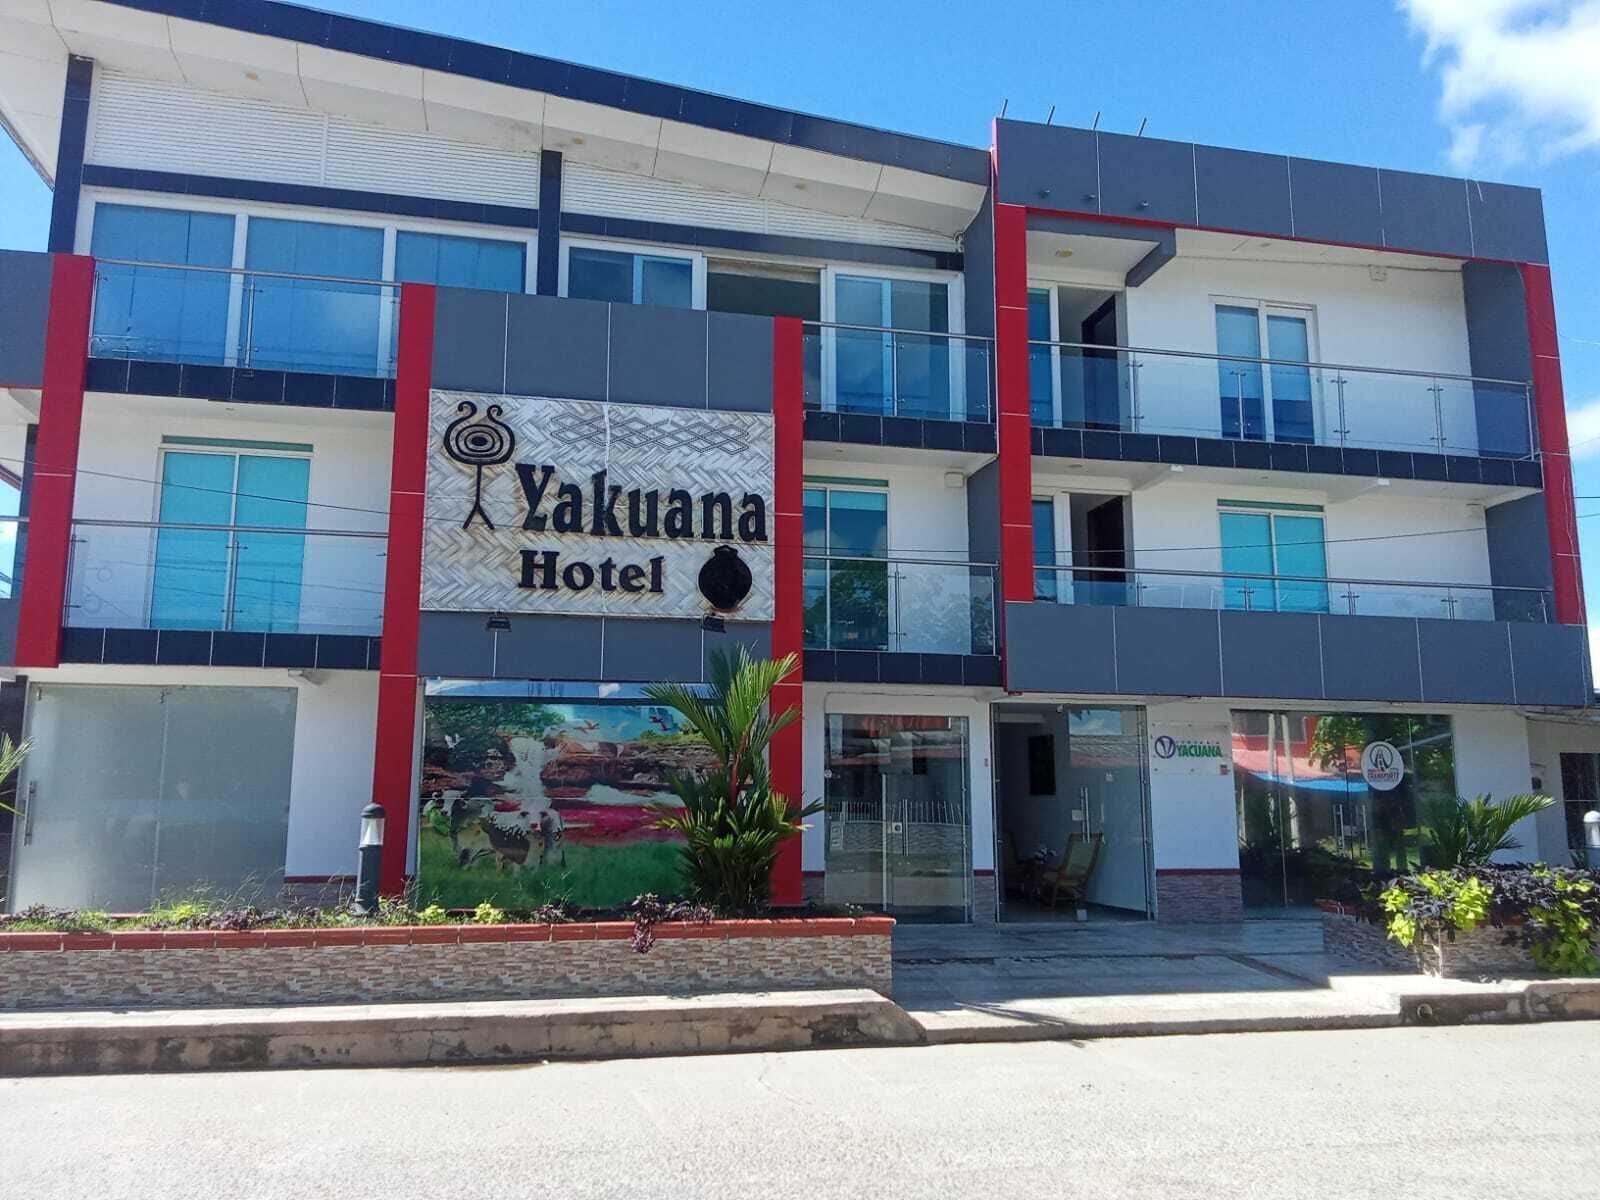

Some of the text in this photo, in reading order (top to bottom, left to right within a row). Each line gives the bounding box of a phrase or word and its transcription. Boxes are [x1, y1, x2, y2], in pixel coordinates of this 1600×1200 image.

[515, 463, 768, 542] Yakuana
[518, 550, 664, 593] Hotel
[1176, 744, 1223, 758] YACUANA
